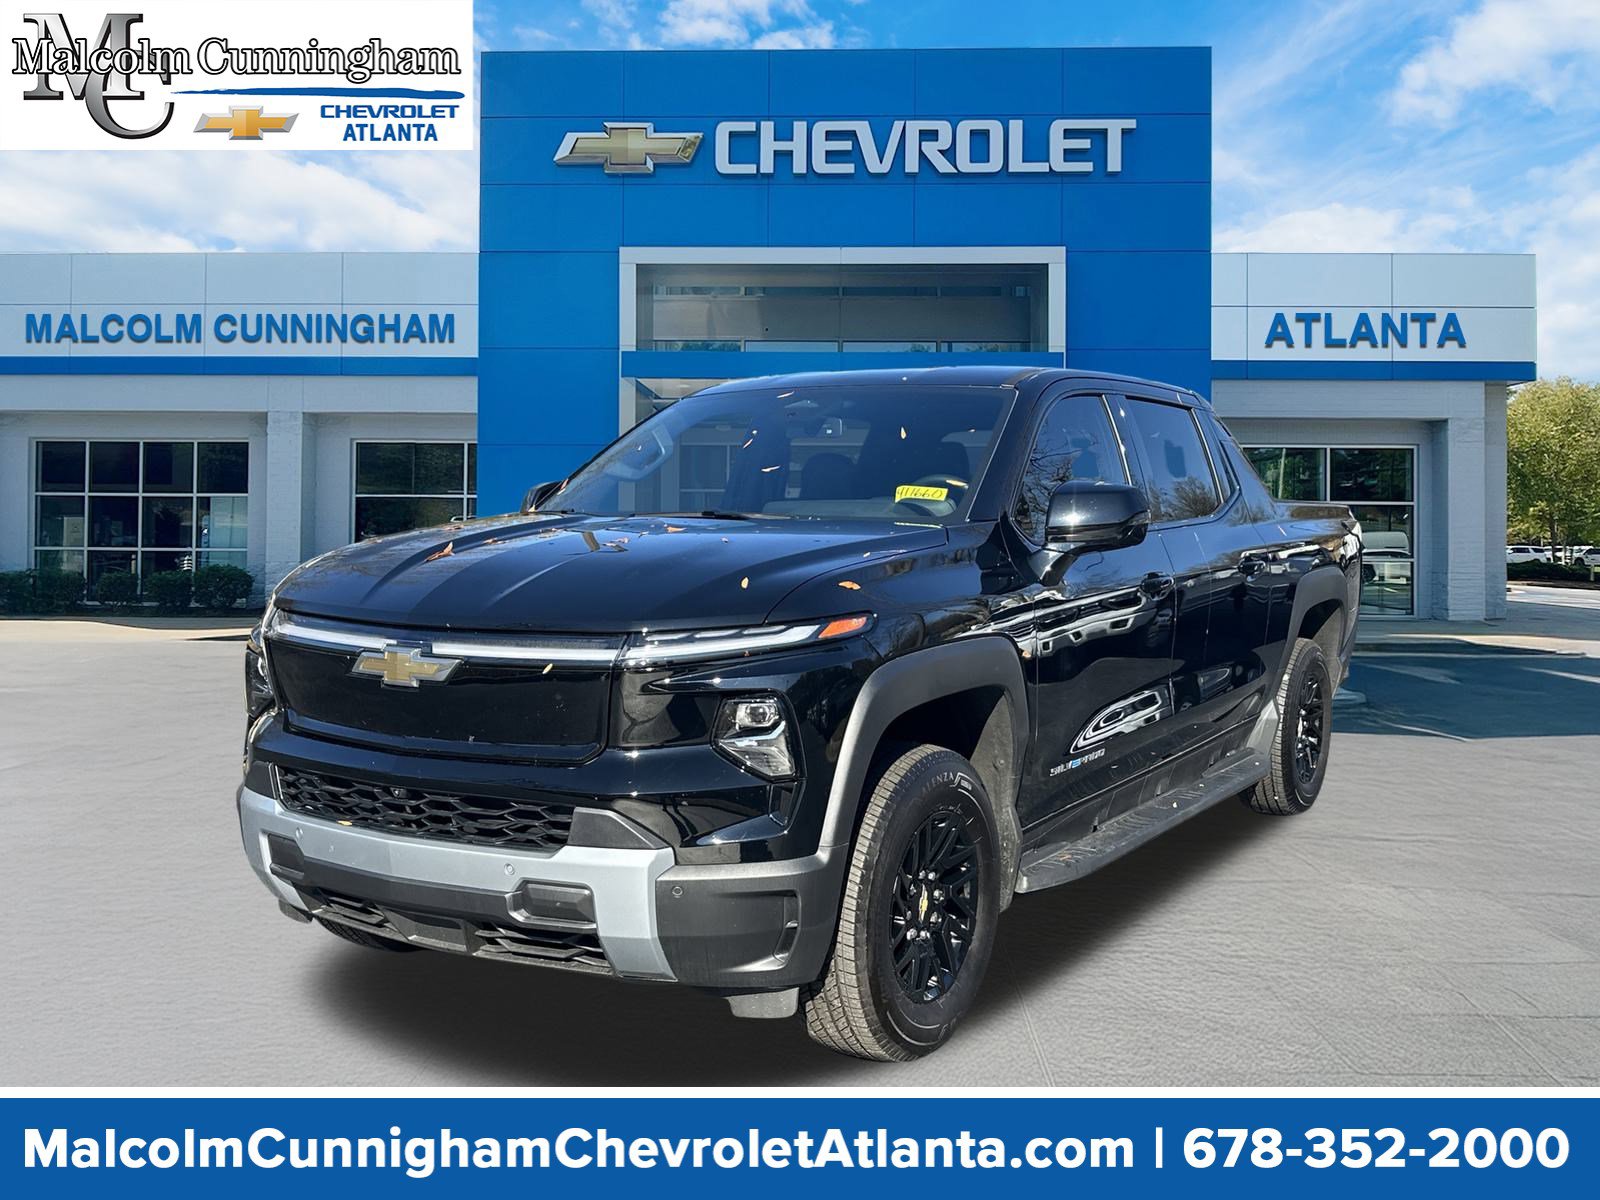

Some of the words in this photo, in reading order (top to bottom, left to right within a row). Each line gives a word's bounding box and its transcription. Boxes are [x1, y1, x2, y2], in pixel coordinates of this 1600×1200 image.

[714, 118, 1138, 176] CHEVROLET
[24, 312, 203, 344] MALCOLM
[213, 312, 456, 344] CUNNINGHAM
[1264, 312, 1467, 349] ATLANTA
